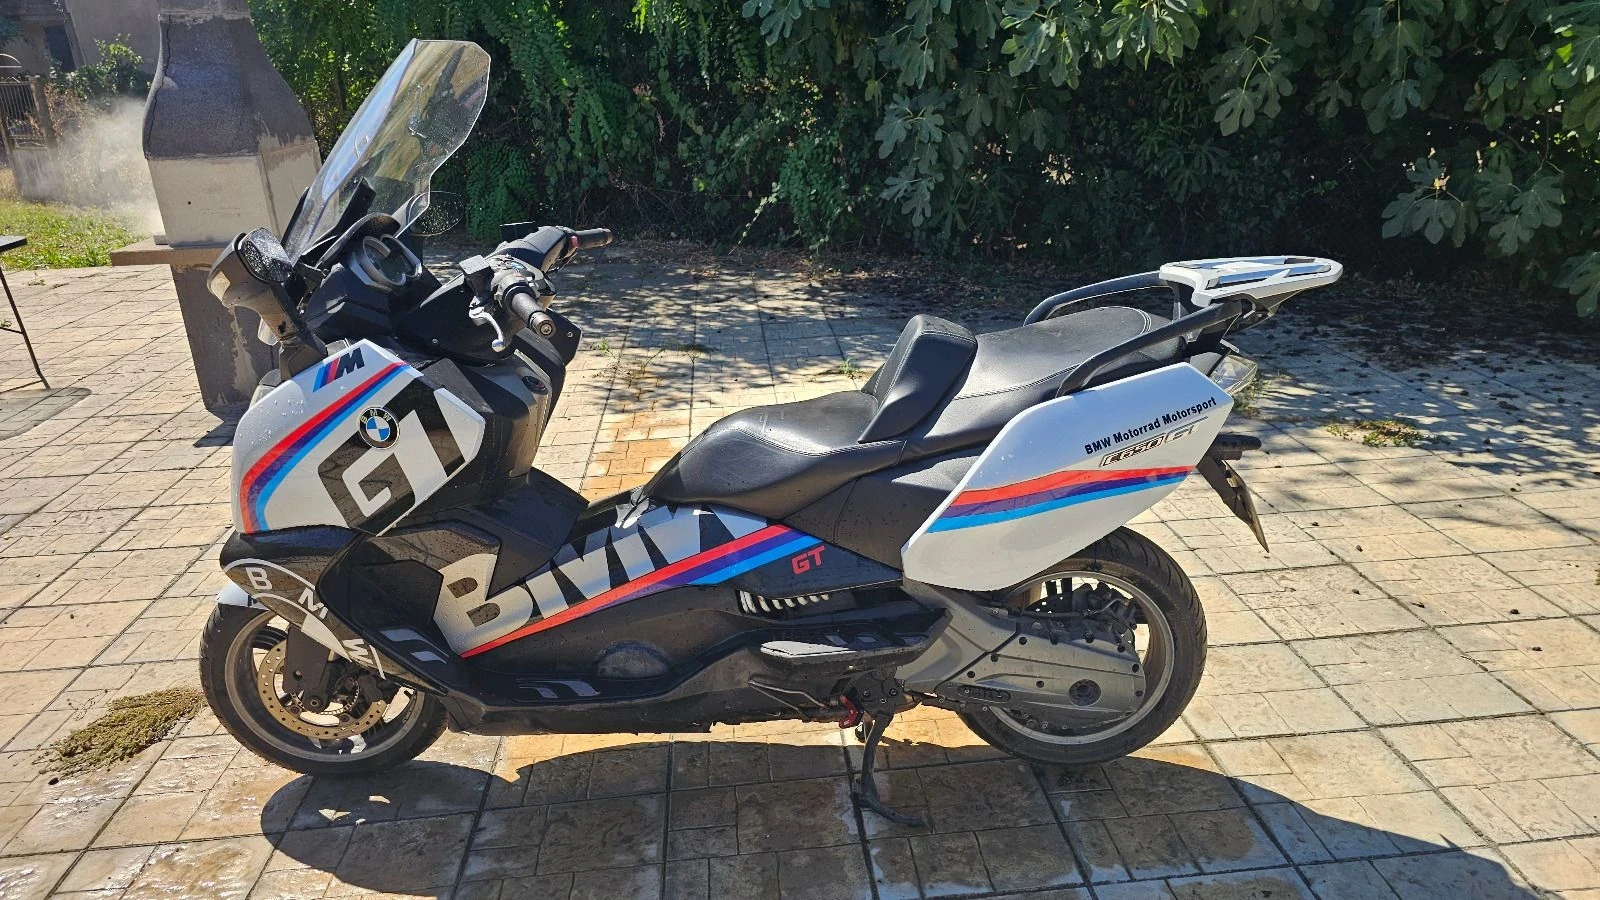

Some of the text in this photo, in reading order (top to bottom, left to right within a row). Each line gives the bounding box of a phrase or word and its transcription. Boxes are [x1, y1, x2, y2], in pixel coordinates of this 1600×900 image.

[1085, 397, 1217, 455] BMW Motorrad Motorsport
[433, 505, 767, 654] BMW
[791, 546, 825, 575] GT
